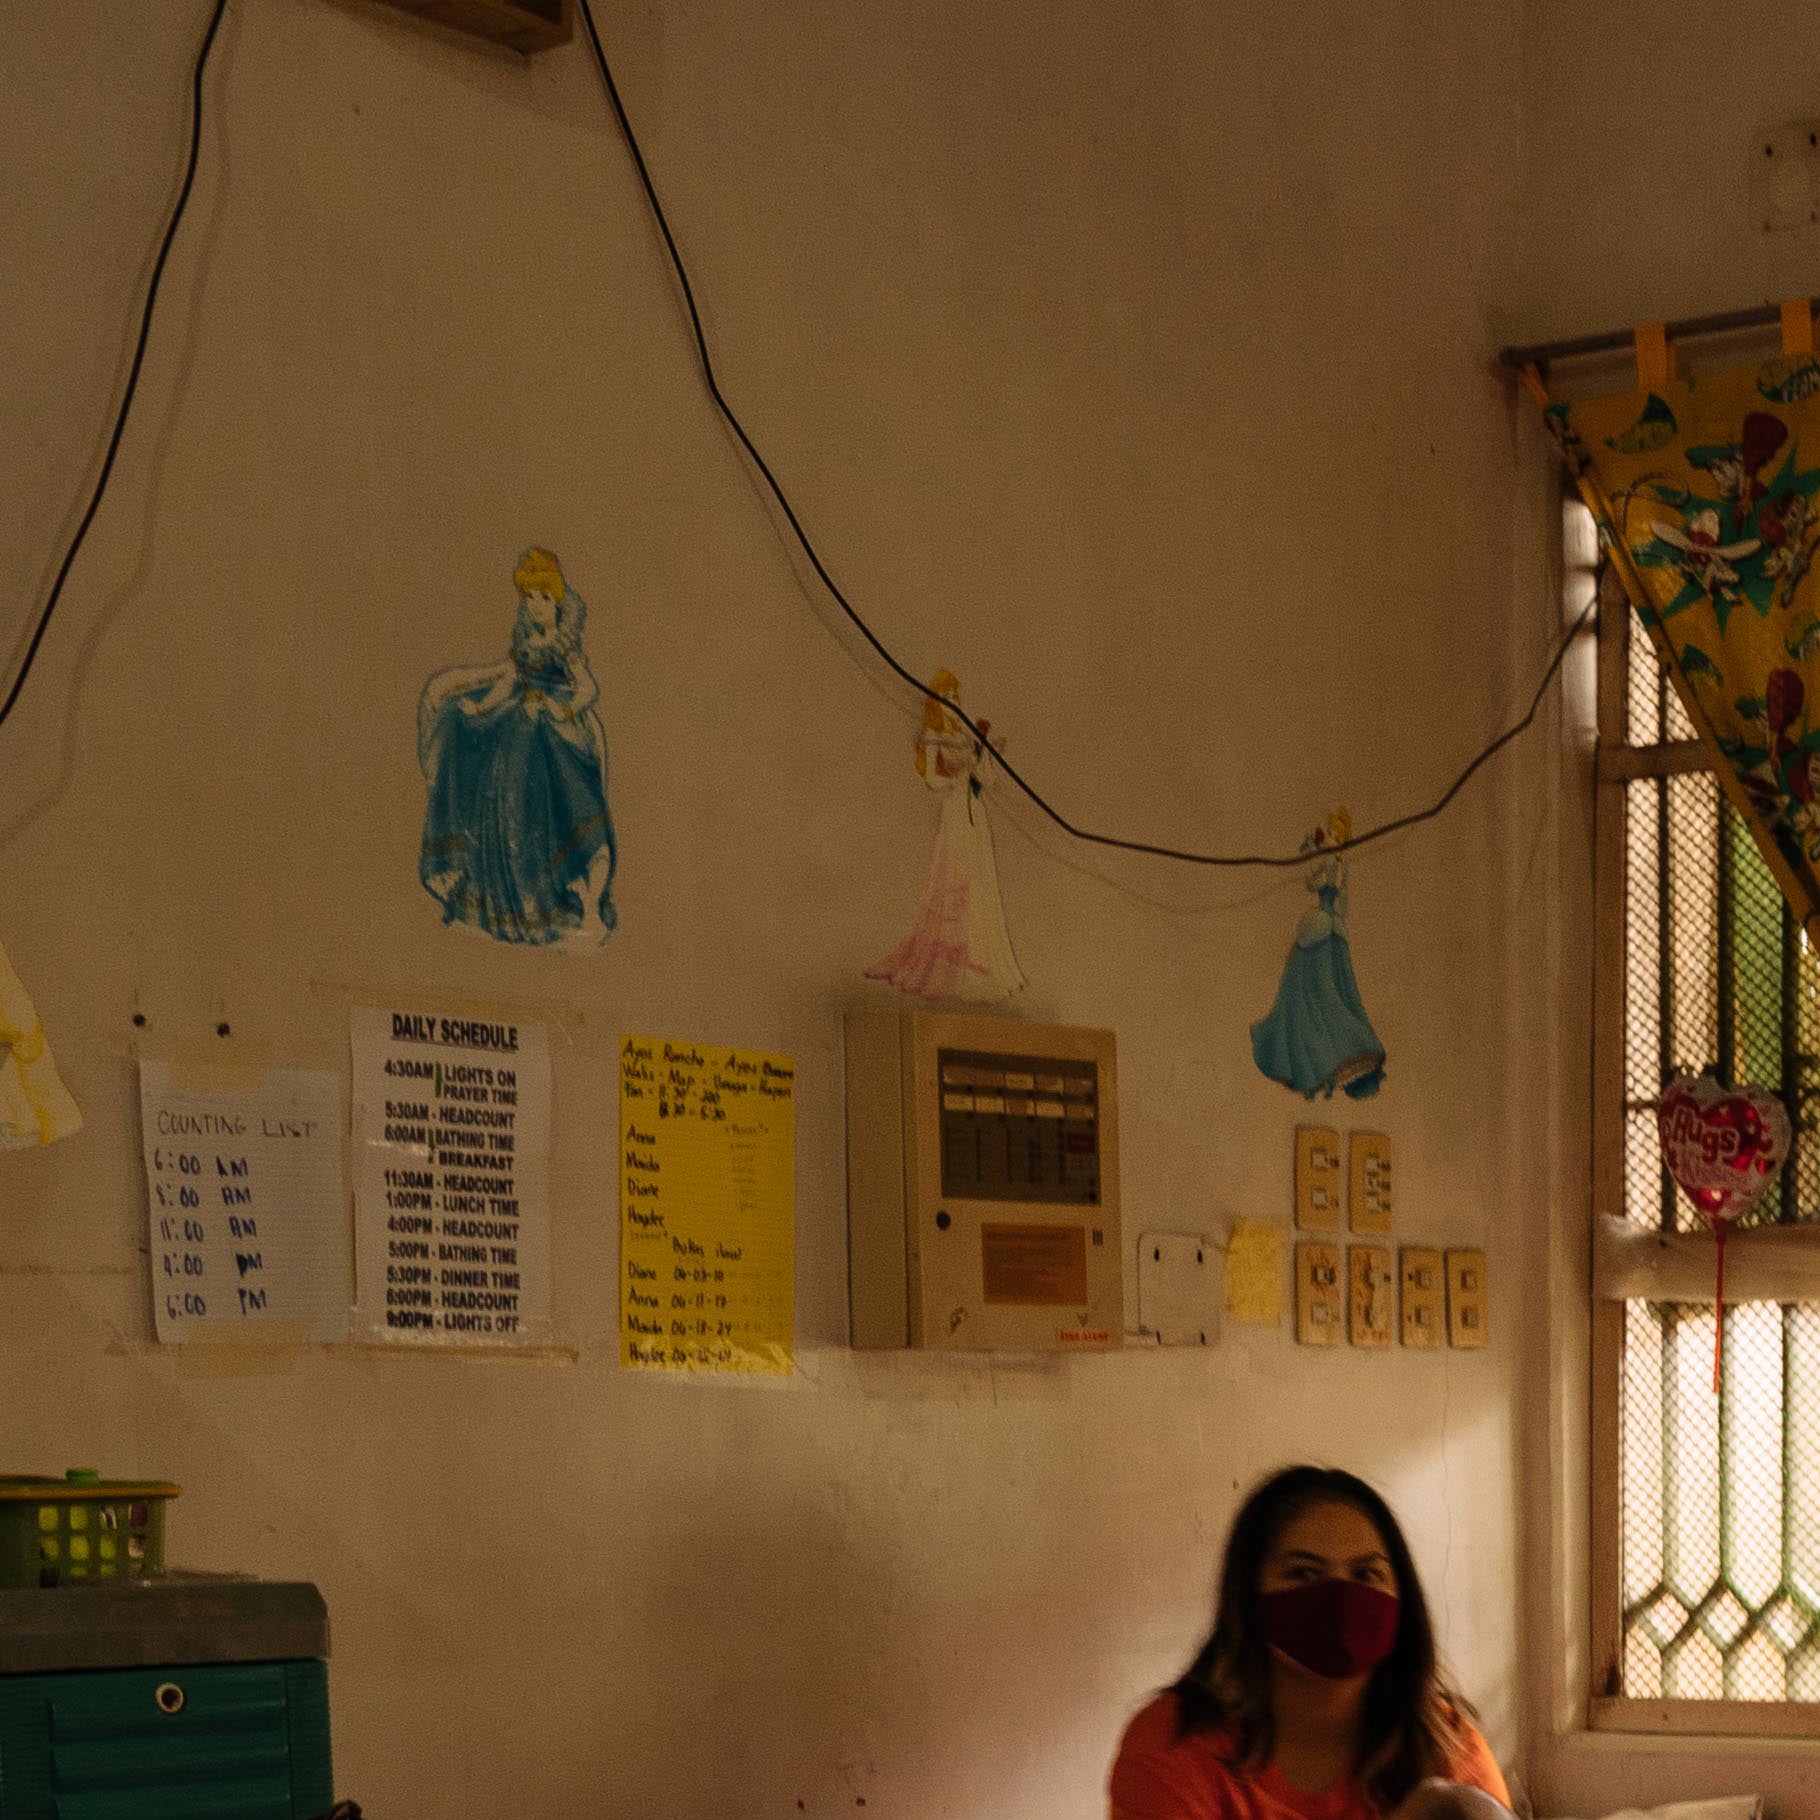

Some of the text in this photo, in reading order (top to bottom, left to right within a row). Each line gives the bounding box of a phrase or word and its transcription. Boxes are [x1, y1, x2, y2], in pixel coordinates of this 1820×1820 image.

[392, 1013, 518, 1050] DAILY SCHEDULE
[385, 1060, 517, 1089] 4:30AM LIGHTS ON
[443, 1085, 518, 1106] PRAYER TIME
[157, 1110, 312, 1138] COUNTING LIST
[385, 1101, 515, 1128] 5:30AM HEADCOUNT
[384, 1123, 515, 1152] 6:00AM BATHING TIME
[216, 1155, 249, 1178] AM
[438, 1151, 514, 1170] BREAKFAST
[384, 1170, 514, 1196] 11:30AM HEADCOUNT
[221, 1186, 252, 1206] AM
[386, 1191, 519, 1217] 1:00PM LUNCH TIME
[229, 1216, 257, 1239] AM
[387, 1217, 519, 1240] 4:00PM HEADCOUNT
[236, 1252, 263, 1279] PM
[389, 1241, 517, 1265] 5:00PM BATHING TIME
[387, 1265, 521, 1290] 5:30PM DINNER TIME
[237, 1288, 267, 1316] PM
[387, 1288, 519, 1311] 6:00PM HEADCOUNT
[387, 1310, 520, 1333] 9:00PM LIGHTS OFF
